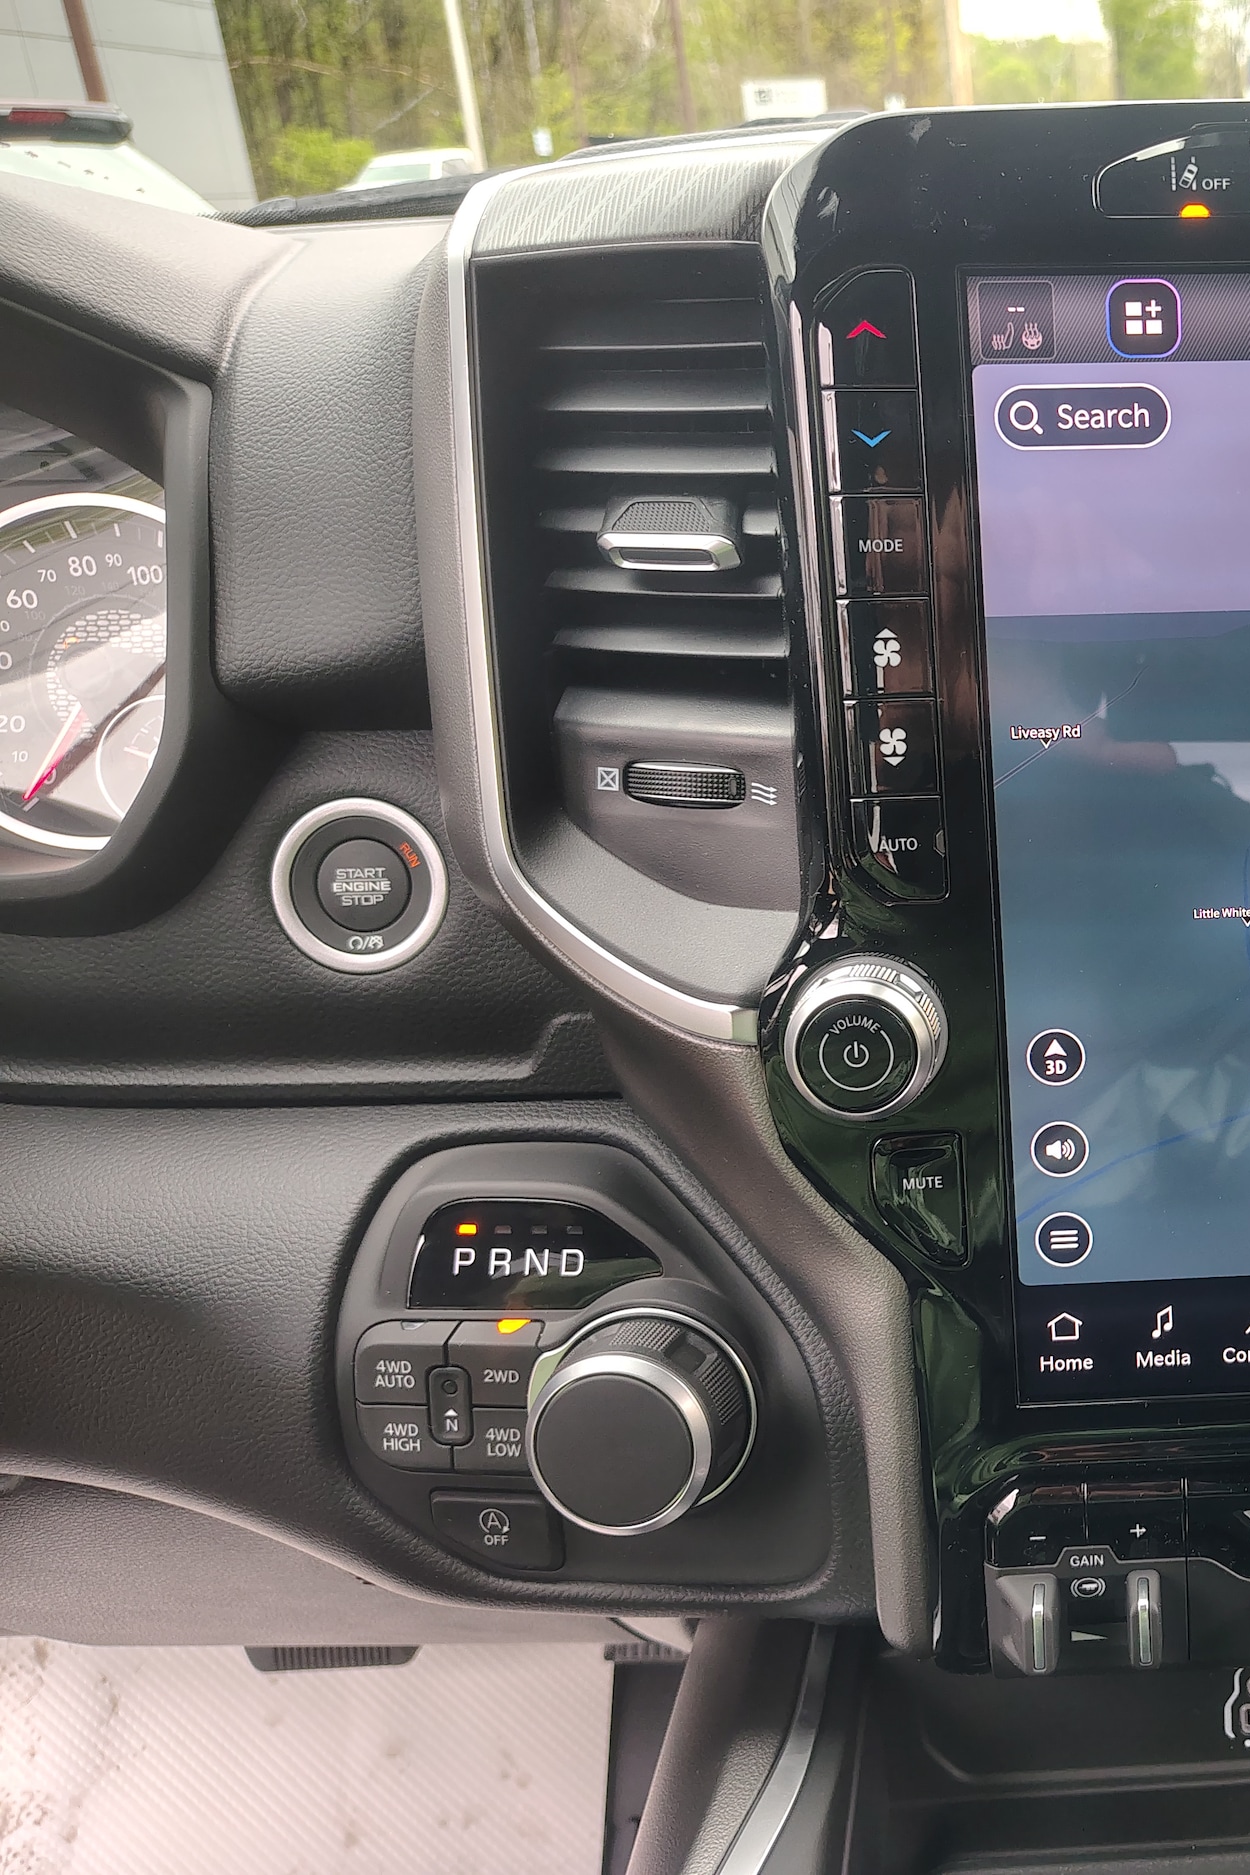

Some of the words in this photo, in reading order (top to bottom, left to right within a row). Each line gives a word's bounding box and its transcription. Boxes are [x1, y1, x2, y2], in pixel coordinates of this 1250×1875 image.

[1201, 176, 1231, 192] OFF
[1056, 402, 1151, 430] Search
[858, 538, 904, 553] MODE
[67, 555, 97, 577] 80
[105, 553, 122, 567] 90
[37, 569, 57, 582] 70
[127, 565, 163, 586] 100
[64, 585, 86, 596] 120
[6, 589, 38, 609] 60
[0, 620, 10, 632] 0
[0, 651, 12, 670] 0
[0, 714, 26, 733] 20
[1010, 726, 1059, 742] Liveasy
[1061, 724, 1081, 738] Rd
[12, 750, 28, 762] 10
[879, 836, 918, 852] AUTO
[399, 841, 421, 868] RUN
[336, 867, 386, 879] START
[333, 881, 391, 892] ENGINE
[341, 894, 384, 906] STOP
[1193, 908, 1220, 919] Little
[828, 1015, 881, 1036] VOLUME
[1045, 1060, 1067, 1075] 3D
[902, 1176, 944, 1190] MUTE
[453, 1247, 476, 1277] P
[488, 1247, 511, 1278] R
[523, 1248, 550, 1277] N
[560, 1247, 585, 1277] D
[376, 1359, 412, 1373] 4WD
[1040, 1356, 1093, 1371] Home
[1136, 1350, 1191, 1368] Media
[375, 1374, 416, 1389] AUTO
[483, 1369, 520, 1384] 2WD
[384, 1423, 419, 1437] 4WD
[446, 1418, 458, 1432] N
[485, 1428, 521, 1442] 4WD
[383, 1438, 421, 1452] HIGH
[487, 1442, 521, 1458] LOW
[484, 1533, 509, 1546] OFF
[1069, 1555, 1104, 1568] GAIN
